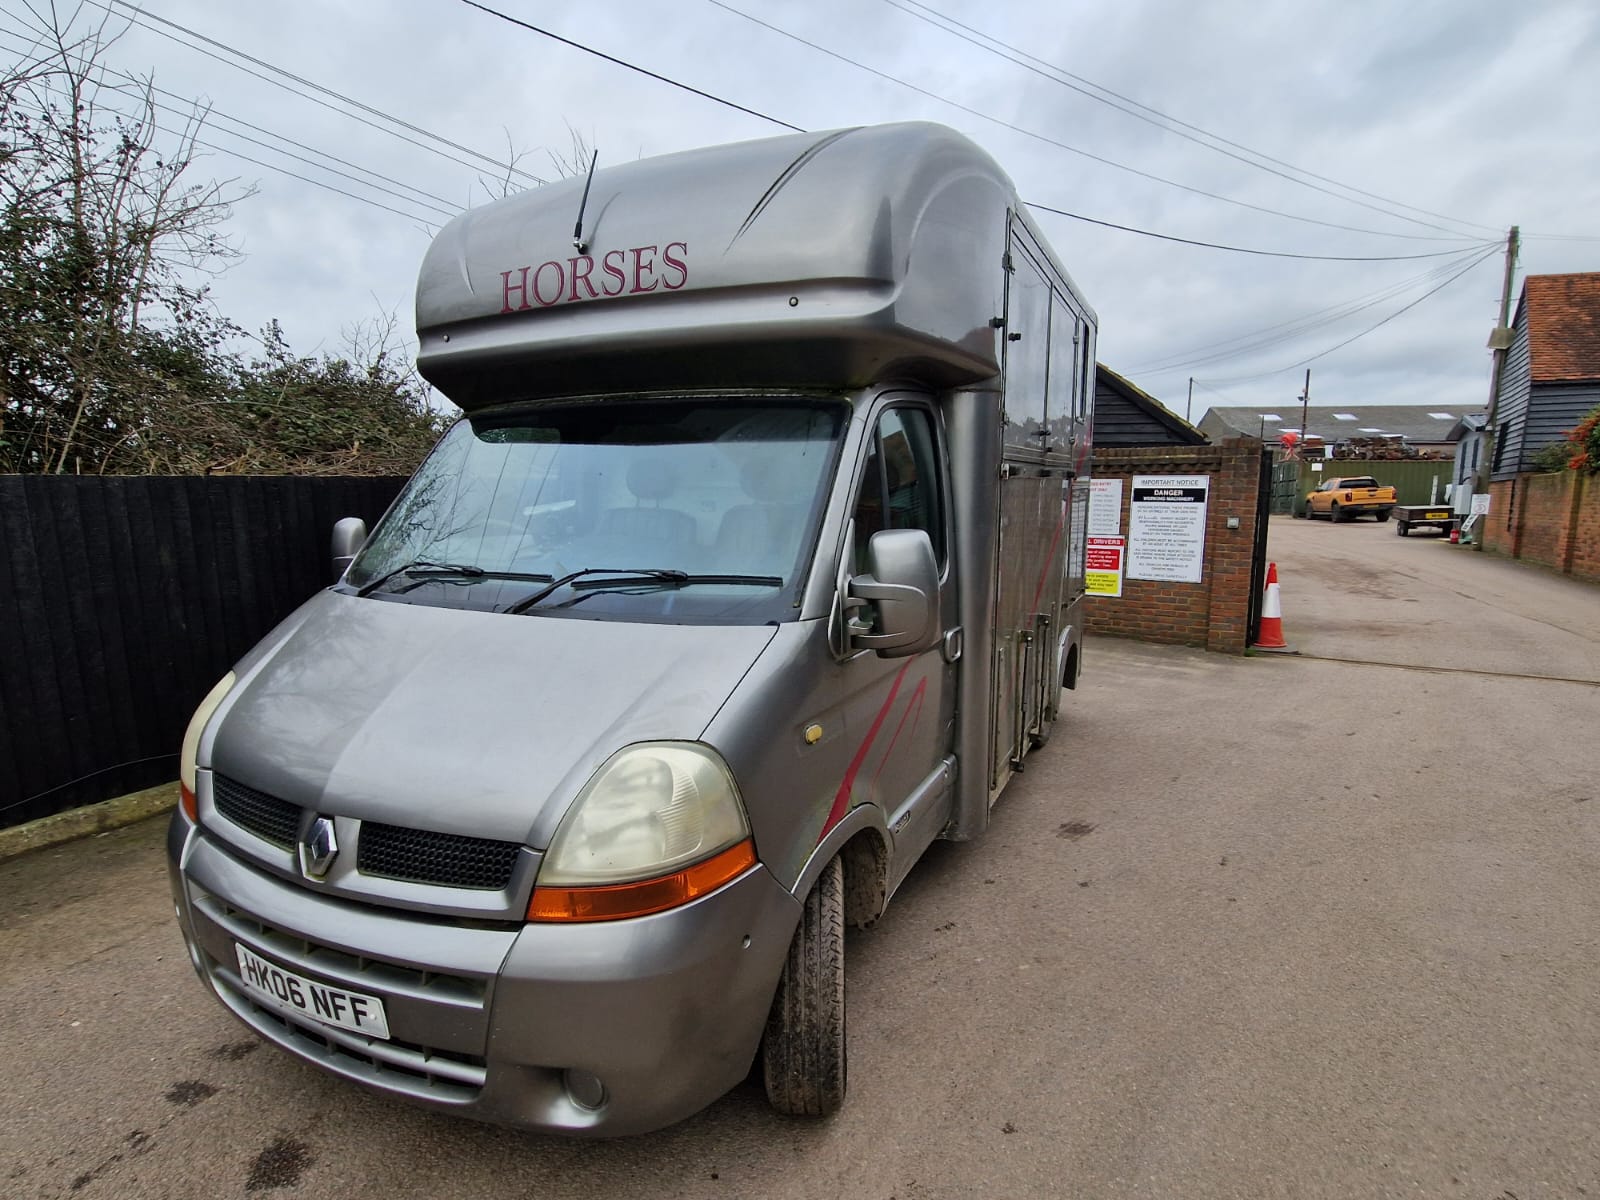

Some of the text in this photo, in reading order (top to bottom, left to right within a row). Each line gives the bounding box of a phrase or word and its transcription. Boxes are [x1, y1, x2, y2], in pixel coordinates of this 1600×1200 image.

[499, 242, 688, 314] HORSES
[243, 952, 368, 1026] HK06 NFF
